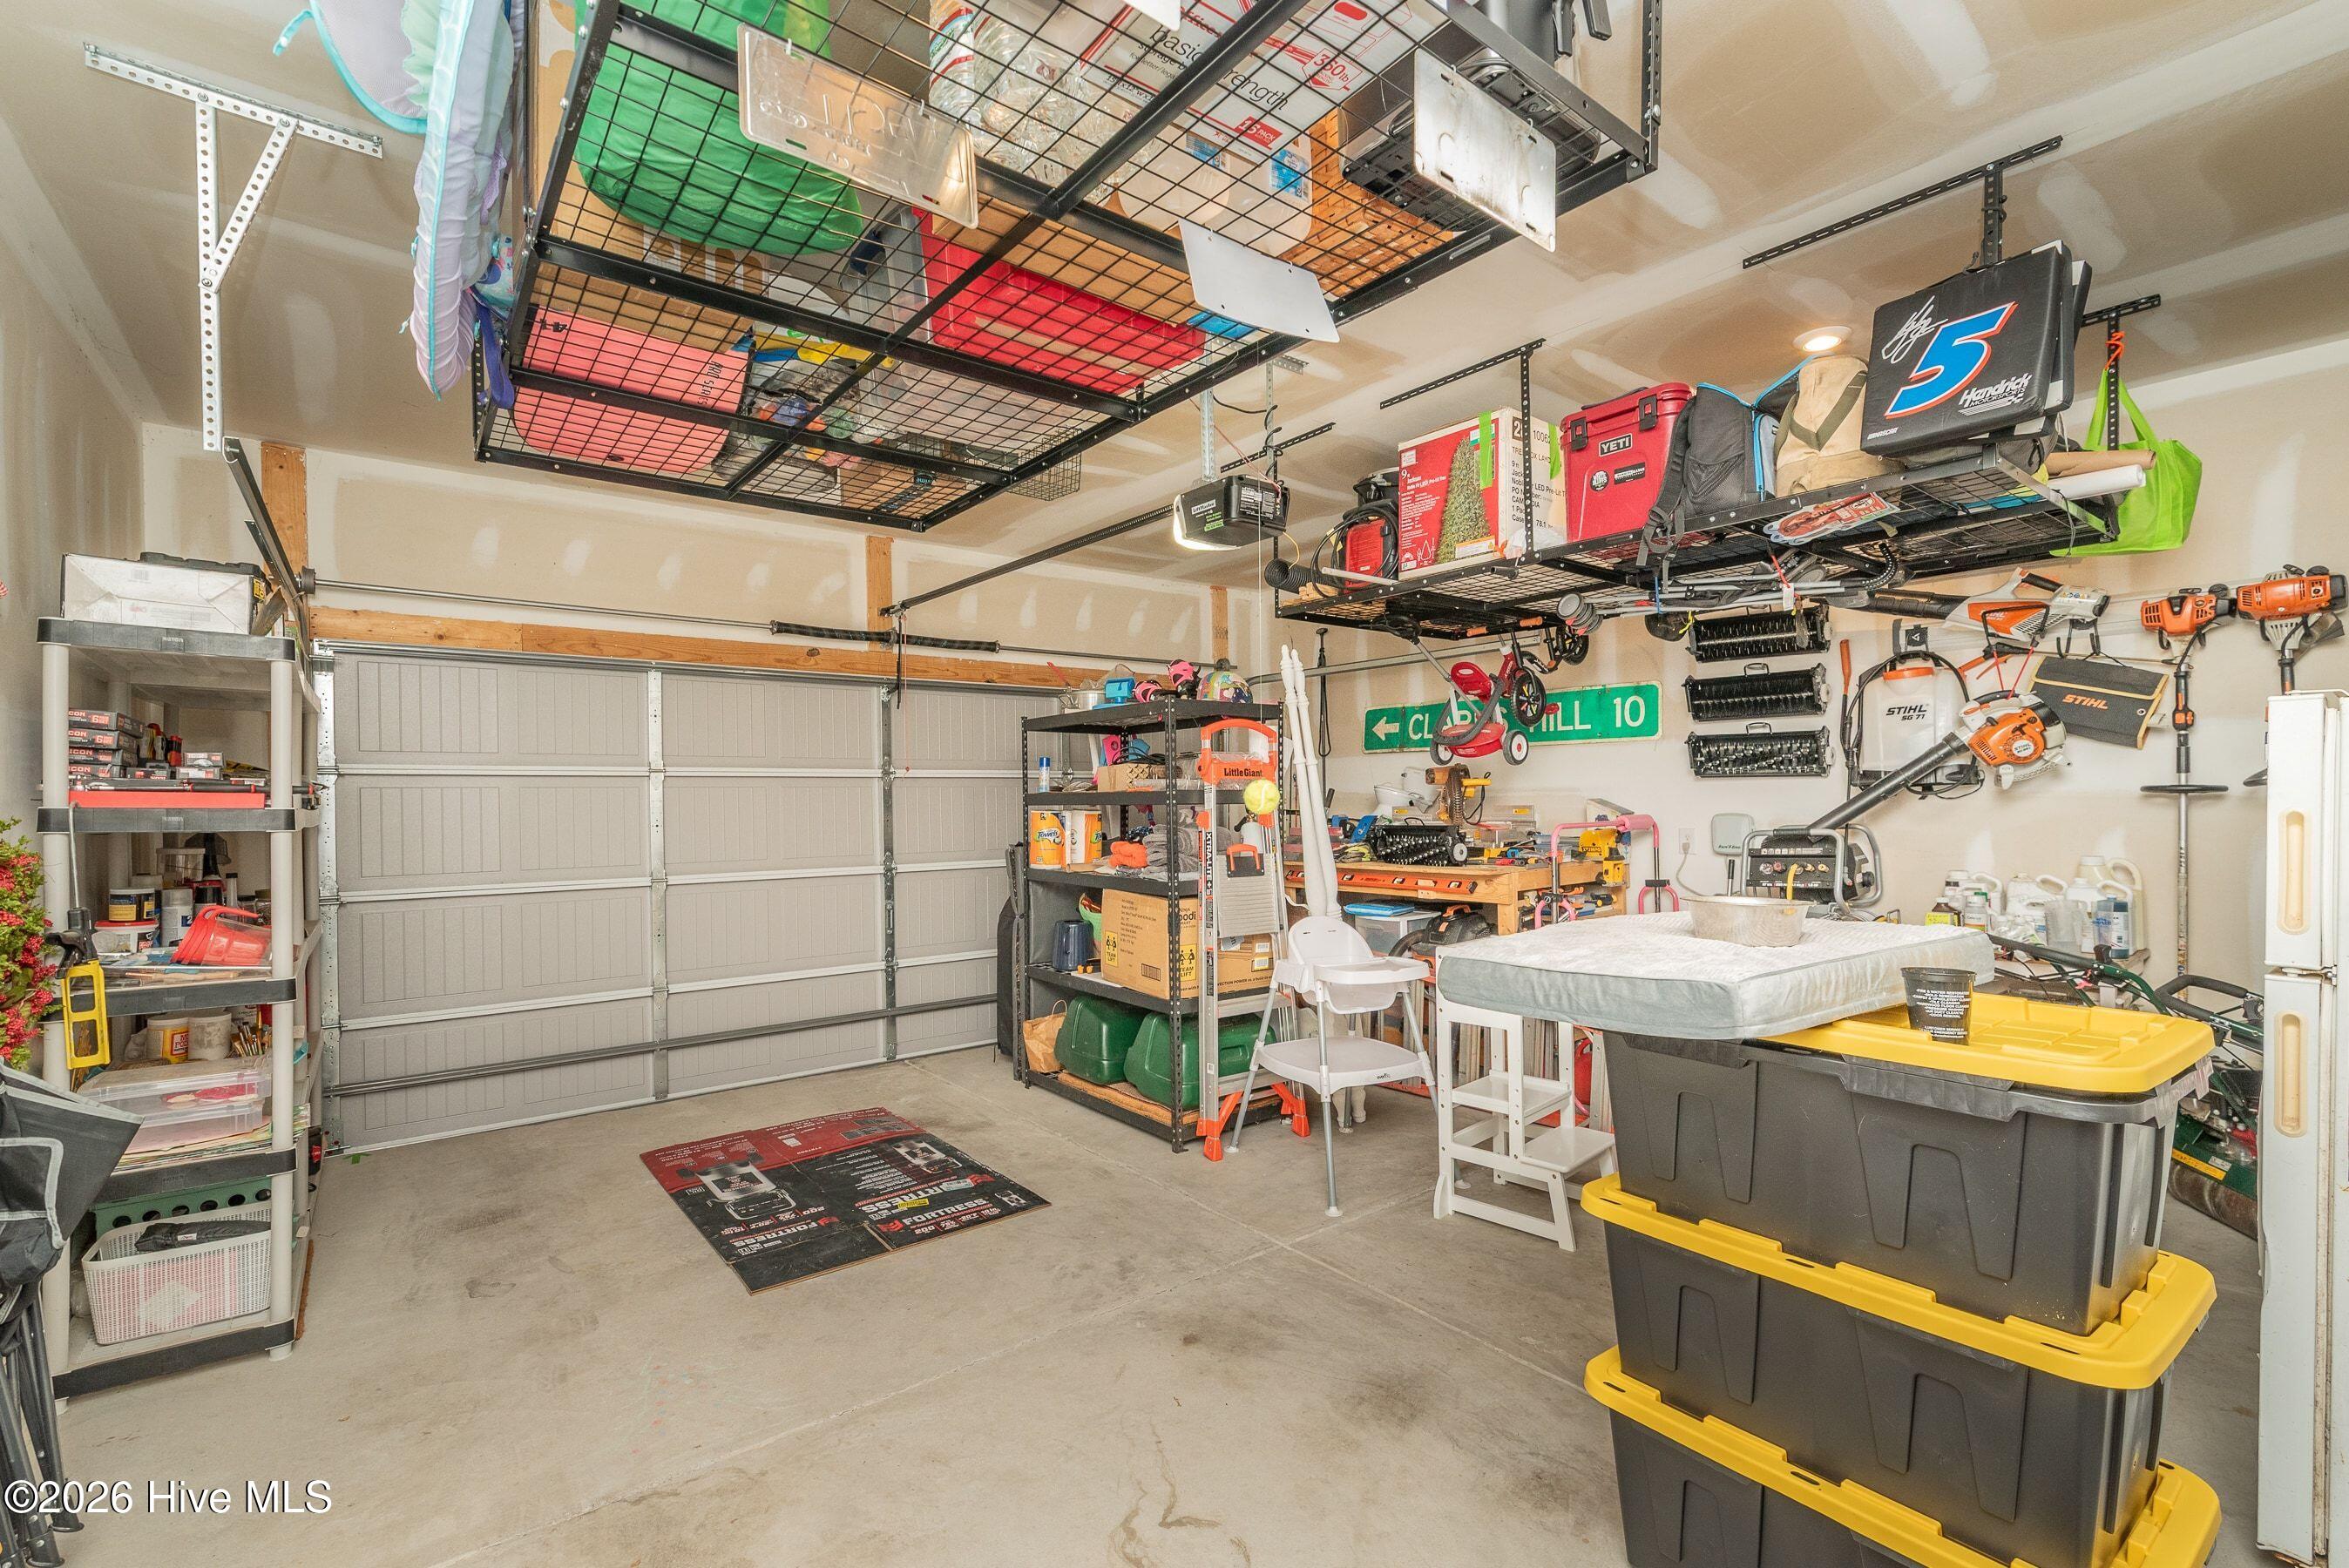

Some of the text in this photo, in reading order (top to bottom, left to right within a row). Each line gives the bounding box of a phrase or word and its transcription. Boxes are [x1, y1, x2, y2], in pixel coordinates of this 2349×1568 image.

[1149, 24, 1204, 63] basic
[1223, 69, 1288, 110] rength
[1884, 301, 2018, 420] 5
[697, 380, 714, 405] SERES
[1959, 373, 2033, 408] Hendrick
[1970, 388, 2026, 407] MOTORSPORTS
[1601, 436, 1630, 453] YETI
[1401, 470, 1407, 479] 9
[1535, 483, 1545, 492] LED
[1613, 695, 1646, 728] 10
[1885, 705, 1927, 716] STIHL
[2062, 694, 2109, 710] STIHL
[1179, 911, 1196, 922] oodi
[861, 1185, 946, 1213] RTRESS
[902, 1198, 988, 1225] FORTRESS
[732, 1221, 818, 1247] FORTRESS
[915, 1225, 935, 1234] 200
